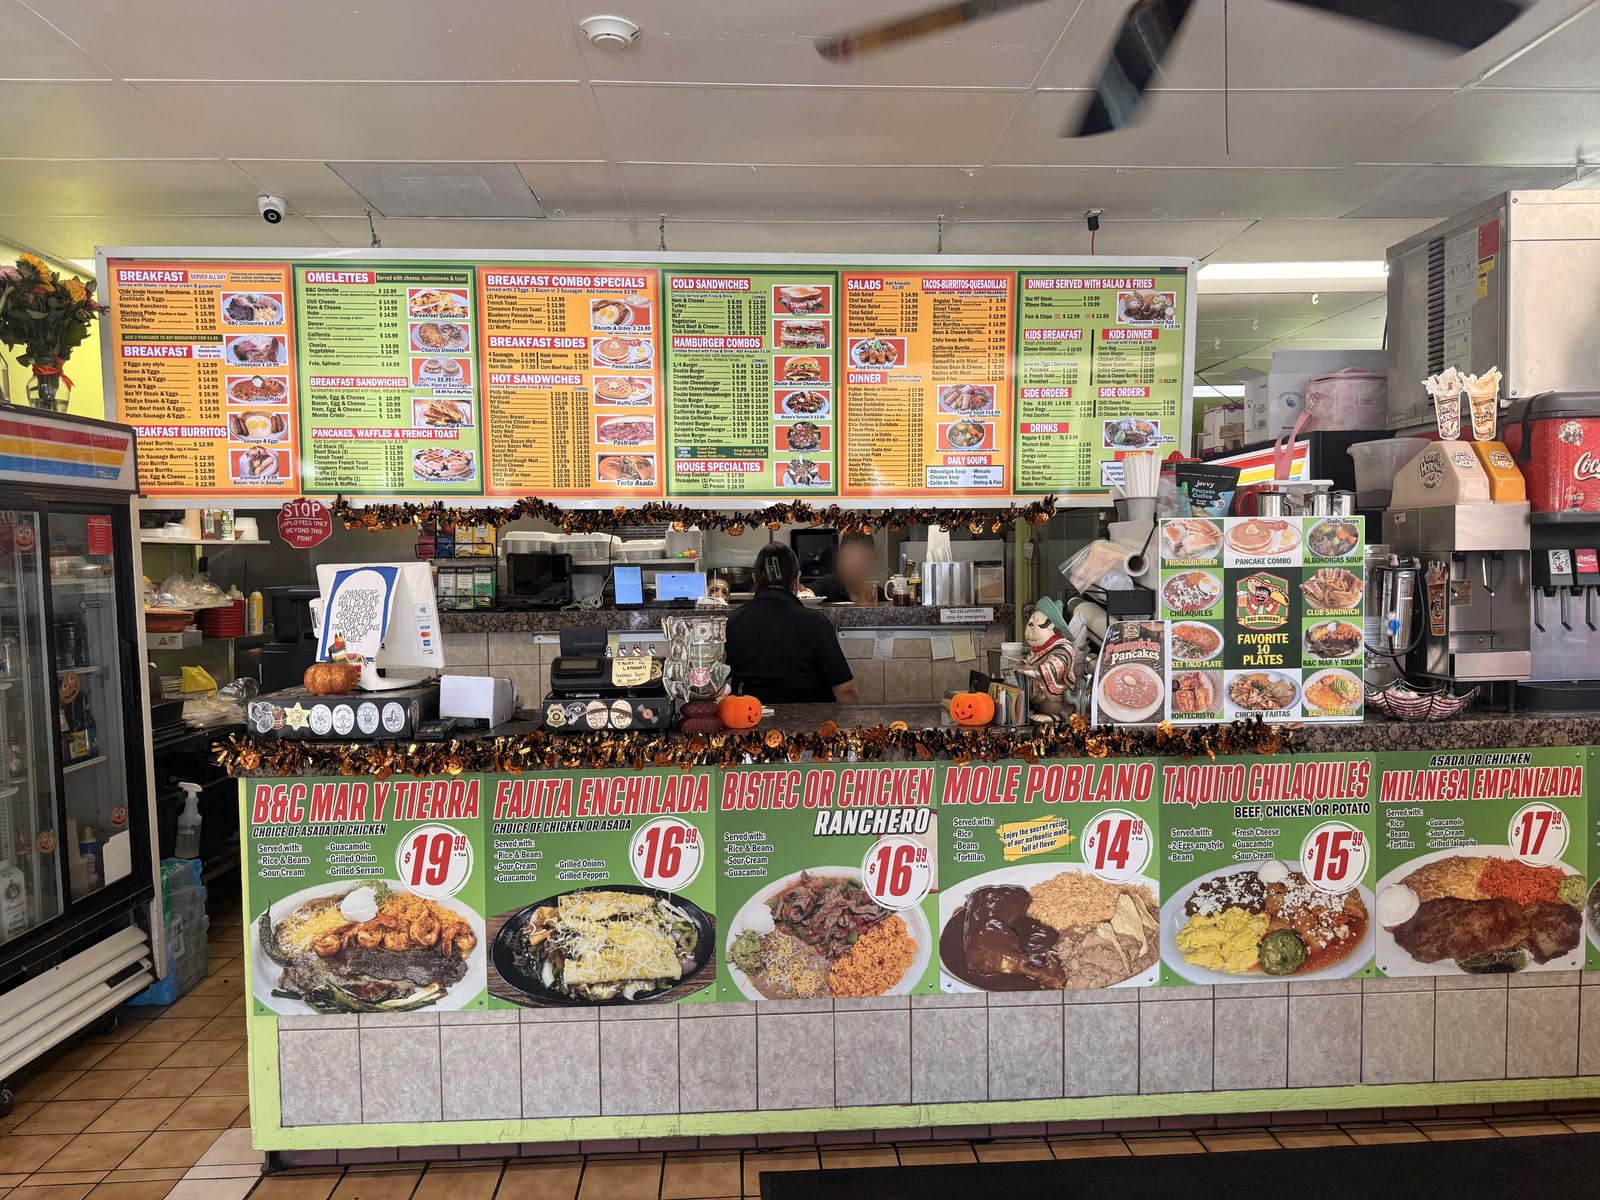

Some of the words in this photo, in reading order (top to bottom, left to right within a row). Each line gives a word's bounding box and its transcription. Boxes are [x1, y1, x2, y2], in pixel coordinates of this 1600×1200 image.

[120, 271, 184, 282] BREAKFAST
[308, 272, 368, 283] OMELETTES
[488, 276, 550, 286] BREAKFAST
[552, 276, 592, 287] COMBO
[594, 277, 645, 288] SPECIALS
[672, 278, 694, 289] COLD
[696, 279, 749, 290] SANDWICHES
[848, 280, 882, 290] SALADS
[923, 280, 1007, 290] TACOS-BURRITOS-QUESADILLAS
[1028, 279, 1054, 288] DINNER
[1056, 279, 1083, 288] SERVED
[1084, 279, 1100, 288] WITH
[1102, 279, 1124, 288] SALAD
[1126, 279, 1131, 288] &
[1132, 279, 1152, 288] FRIES
[1025, 330, 1041, 339] KIDS
[1043, 330, 1082, 339] BREAKFAST
[1109, 330, 1126, 339] KIDS
[1127, 330, 1152, 339] DINNER
[490, 337, 552, 347] BREAKFAST
[554, 338, 586, 348] SIDES
[674, 338, 724, 347] HAMBURGER
[726, 338, 760, 348] COMBOS
[124, 346, 188, 357] BREAKFAST
[310, 378, 354, 386] BREAKFAST
[356, 378, 407, 387] SANDWICHES
[491, 374, 512, 383] HOT
[513, 374, 581, 384] SANDWICHES
[849, 373, 881, 383] DINNER
[1024, 388, 1040, 398] SIDE
[1041, 388, 1068, 398] ORDERS
[1100, 388, 1116, 397] SIDE
[1118, 388, 1145, 397] ORDERS
[132, 427, 179, 437] REAKFAST
[181, 427, 226, 437] BURRITOS
[1030, 424, 1058, 432] DRINKS
[312, 429, 356, 438] PANCAKES,
[402, 430, 432, 438] FRENCH
[434, 430, 458, 438] TOAST
[947, 456, 966, 464] DAILY
[967, 456, 988, 464] SOUPS
[677, 462, 706, 471] HOUSE
[708, 462, 761, 472] SPECIALTIES
[1195, 480, 1215, 488] javvy
[284, 502, 320, 517] STOP
[280, 520, 312, 528] EMPLOYEES
[1237, 634, 1289, 644] FAVORITE
[1104, 638, 1160, 661] Pumpkin
[1257, 644, 1270, 654] 10
[1111, 649, 1160, 665] Pancakes
[1243, 655, 1283, 666] PLATES
[1430, 754, 1466, 767] ASADA
[1468, 754, 1482, 765] OR
[1484, 753, 1531, 765] CHICKEN
[942, 766, 1022, 804] MOLE
[1024, 763, 1155, 804] POBLANO
[1163, 764, 1246, 808] TAQUITO
[1248, 760, 1370, 804] CHILAQUILES
[1380, 768, 1470, 803] MILANESA
[1472, 766, 1584, 800] EMPANIZADA
[721, 770, 802, 811] BISTEC
[804, 770, 836, 808] OR
[838, 768, 934, 808] CHICKEN
[252, 783, 307, 824] B&C
[309, 783, 369, 822] MAR
[374, 782, 391, 821] Y
[394, 780, 480, 820] TIERRA
[493, 778, 573, 820] FAJITA
[576, 774, 710, 818] ENCHILADA
[1235, 806, 1264, 820] BEEF,
[1266, 804, 1312, 818] CHICKEN
[1314, 804, 1330, 816] OR
[1332, 802, 1370, 815] POTATO
[814, 808, 931, 836] RANCHERO
[953, 818, 975, 826] Served
[976, 818, 994, 826] with:
[1004, 831, 1018, 840] Enjoy
[1030, 824, 1048, 833] secret
[1049, 820, 1068, 829] recipe
[1026, 832, 1053, 843] authentic
[1040, 840, 1057, 848] flavor
